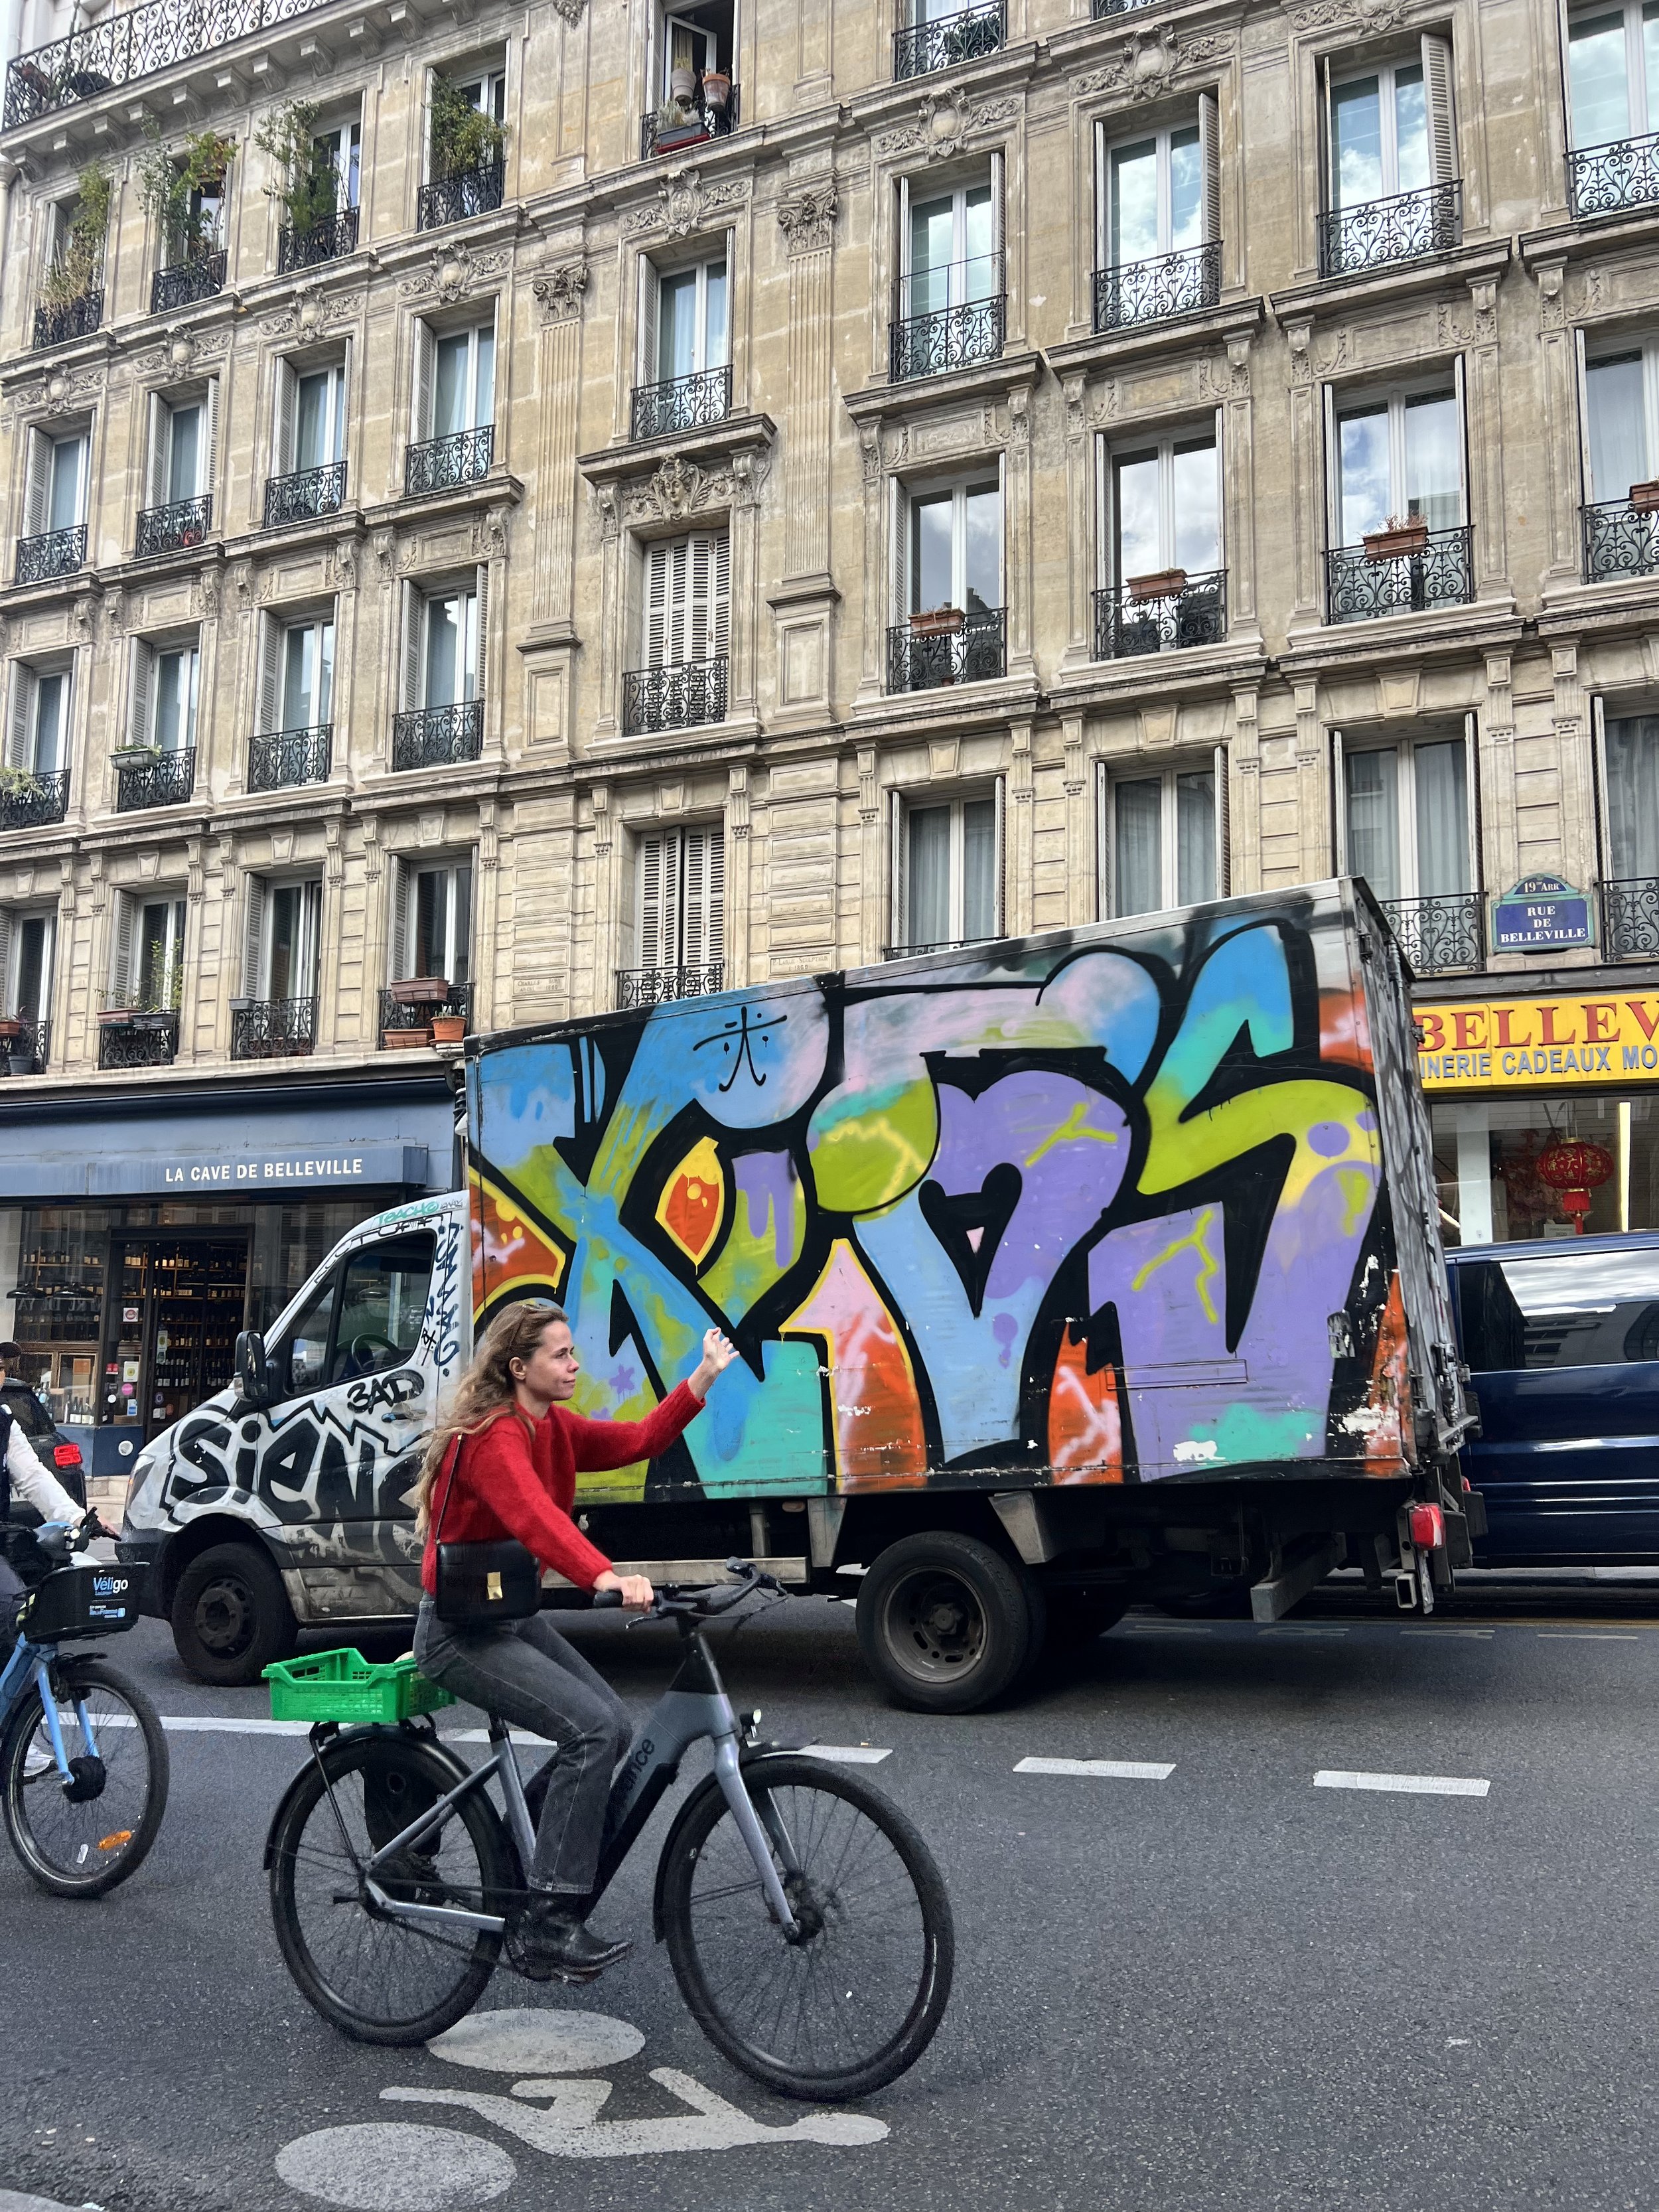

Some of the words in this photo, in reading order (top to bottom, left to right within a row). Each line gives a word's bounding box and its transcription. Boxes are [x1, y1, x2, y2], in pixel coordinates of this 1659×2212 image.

[1527, 905, 1555, 917] RUE
[1533, 918, 1551, 928] DE
[1500, 927, 1586, 943] BELLEVILLE
[1413, 1000, 1659, 1052] BELLEV
[1502, 1047, 1611, 1075] CADEAUX
[1622, 1044, 1659, 1070] MO
[165, 1167, 184, 1183] LA
[190, 1165, 230, 1181] CAVE
[237, 1163, 257, 1179] DE
[264, 1158, 363, 1178] BELLEVILLE
[93, 1576, 129, 1593] Véligo
